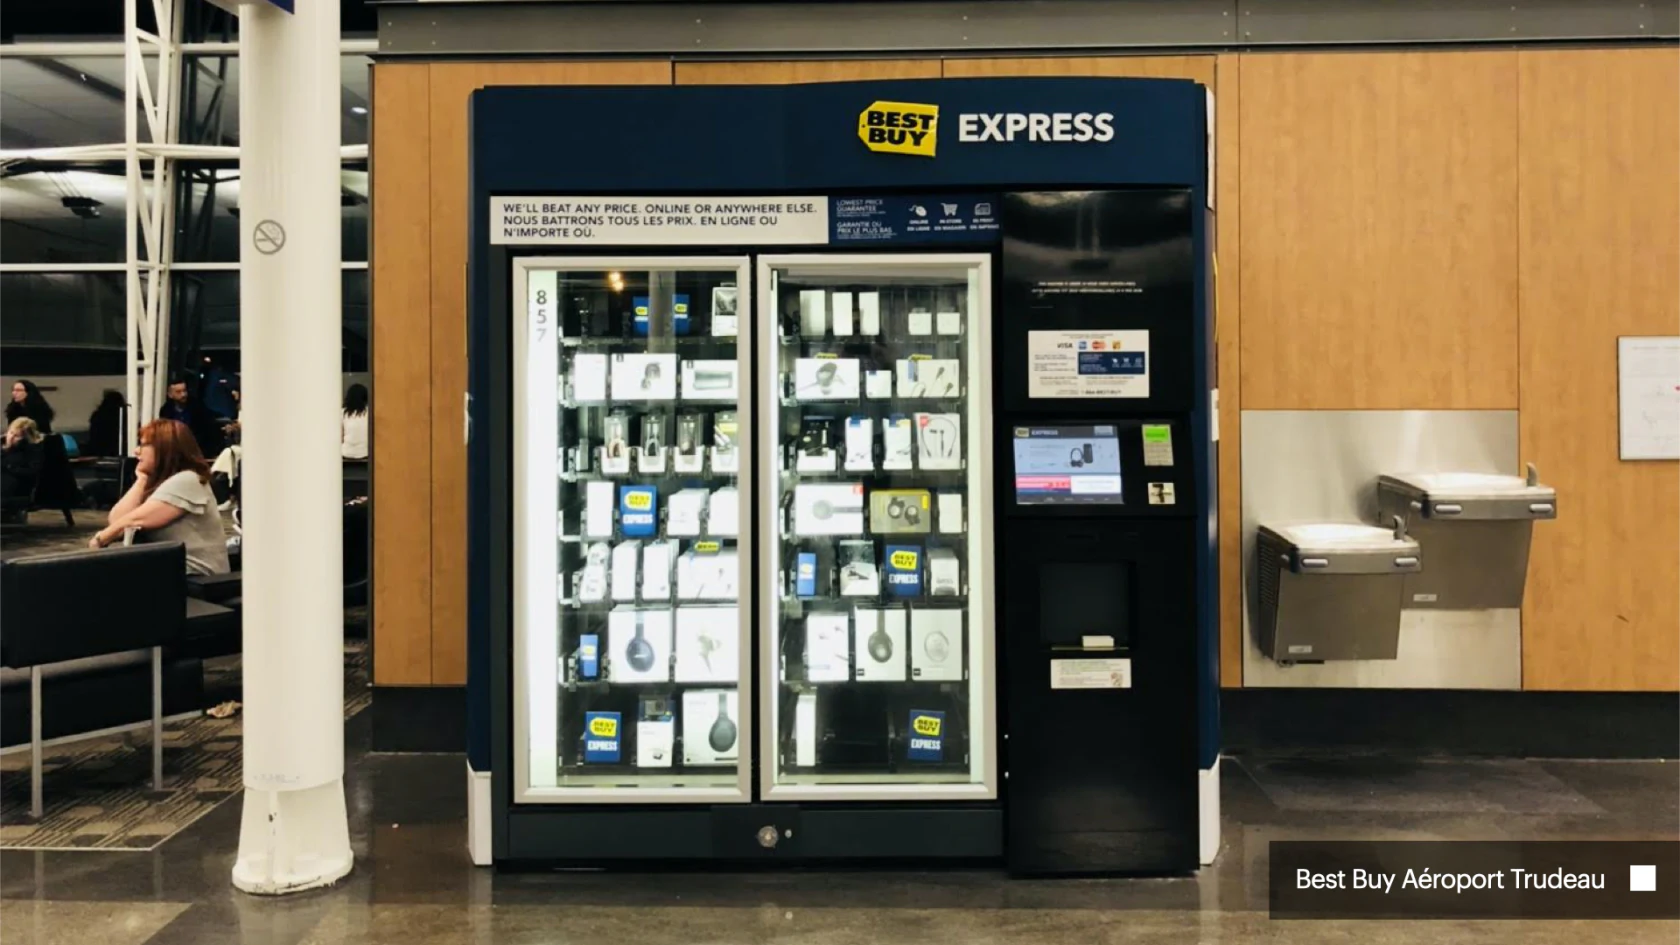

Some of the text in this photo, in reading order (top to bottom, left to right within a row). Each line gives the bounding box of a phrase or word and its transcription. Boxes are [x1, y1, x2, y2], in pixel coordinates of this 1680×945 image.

[868, 111, 935, 130] BEST
[958, 112, 1115, 142] EXPRESS
[868, 127, 928, 147] BUY
[503, 203, 817, 214] WE'LL BEAT ANY PRICE. ONLINE OR ANYWHERE ELSE.
[503, 215, 777, 225] NOUS BATTRONS TOUS LES PRIX. EN LIGNE OU
[503, 227, 569, 237] N'IMPORTE
[917, 719, 939, 728] BEST
[911, 738, 941, 750] EXPRESS
